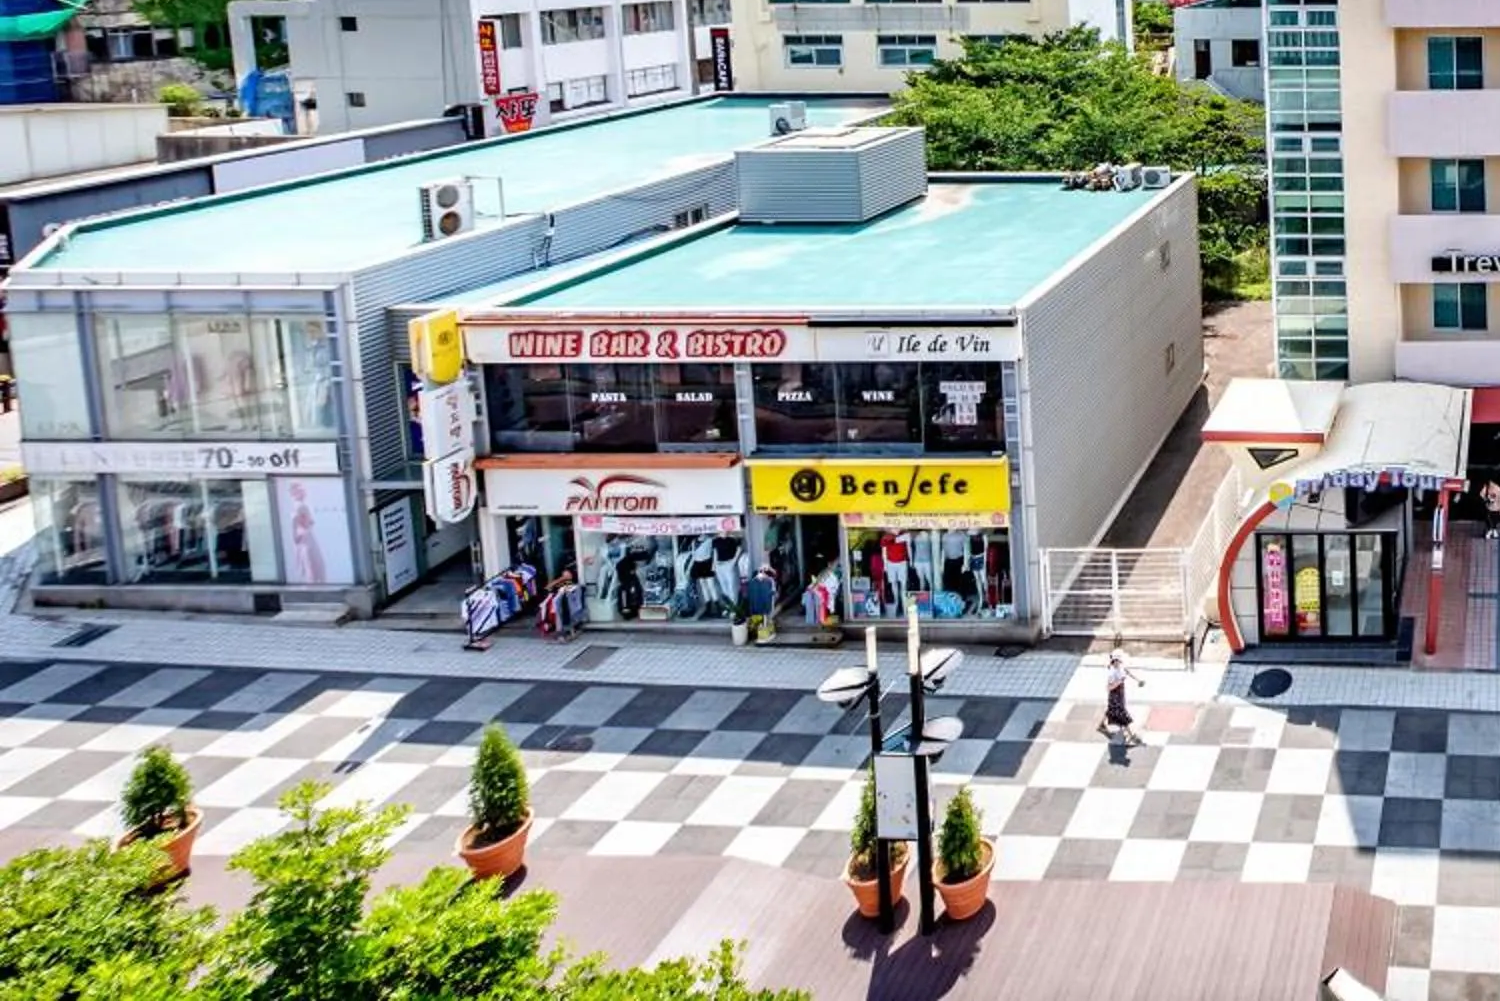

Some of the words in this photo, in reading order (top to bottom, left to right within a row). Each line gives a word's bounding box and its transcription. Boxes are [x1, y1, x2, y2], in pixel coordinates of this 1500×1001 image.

[509, 330, 582, 358] WINE
[590, 328, 650, 358] BAR
[656, 328, 679, 358] &
[686, 328, 786, 358] BISTRO
[927, 334, 947, 353] de
[955, 334, 991, 353] Vin
[591, 392, 627, 402] PASTA
[675, 392, 713, 402] SALAD
[777, 391, 813, 401] PIZZA
[862, 390, 895, 401] WINE
